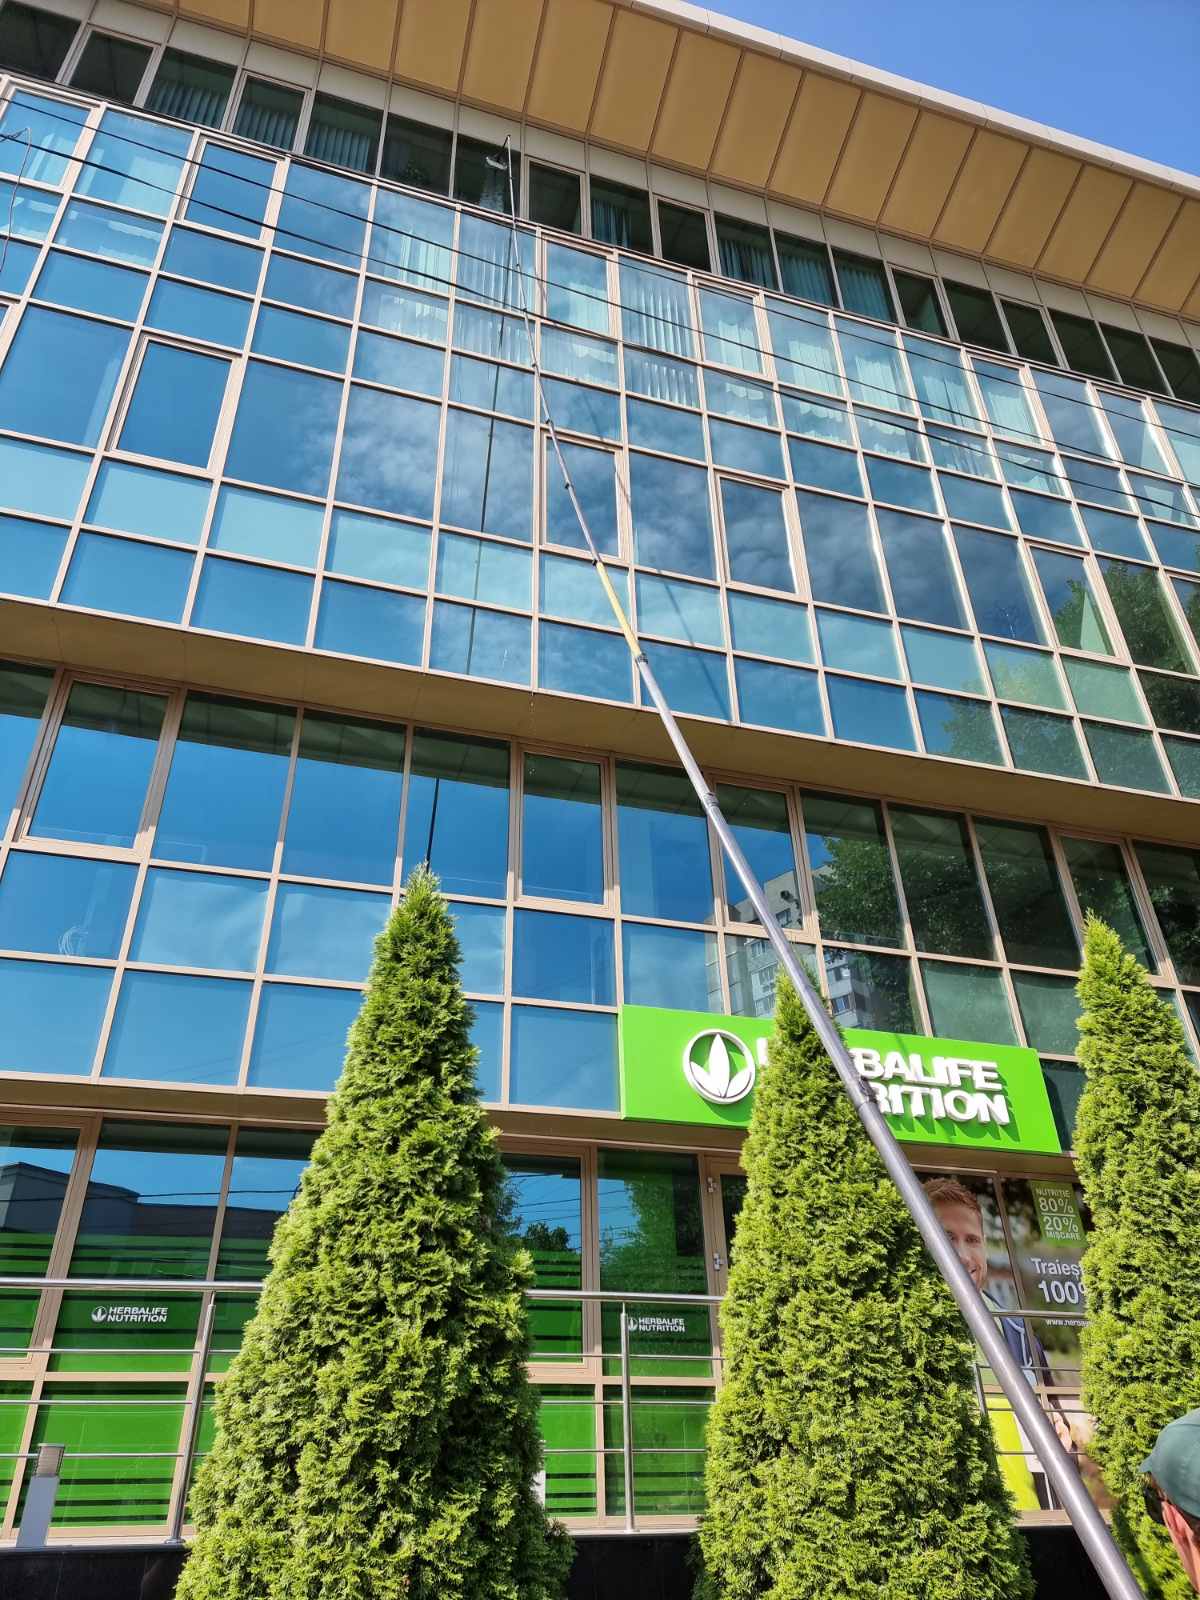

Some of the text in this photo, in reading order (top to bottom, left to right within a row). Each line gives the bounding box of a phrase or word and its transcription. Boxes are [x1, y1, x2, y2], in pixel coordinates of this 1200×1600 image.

[868, 1081, 1010, 1126] RITION
[1039, 1197, 1074, 1214] 80%
[1043, 1216, 1079, 1232] 20%
[1031, 1257, 1083, 1280] Traieș
[109, 1306, 168, 1315] HERBALIFE
[107, 1314, 167, 1323] NUTRITION
[638, 1317, 685, 1325] HERBALIFE
[638, 1324, 685, 1333] NUTRITION
